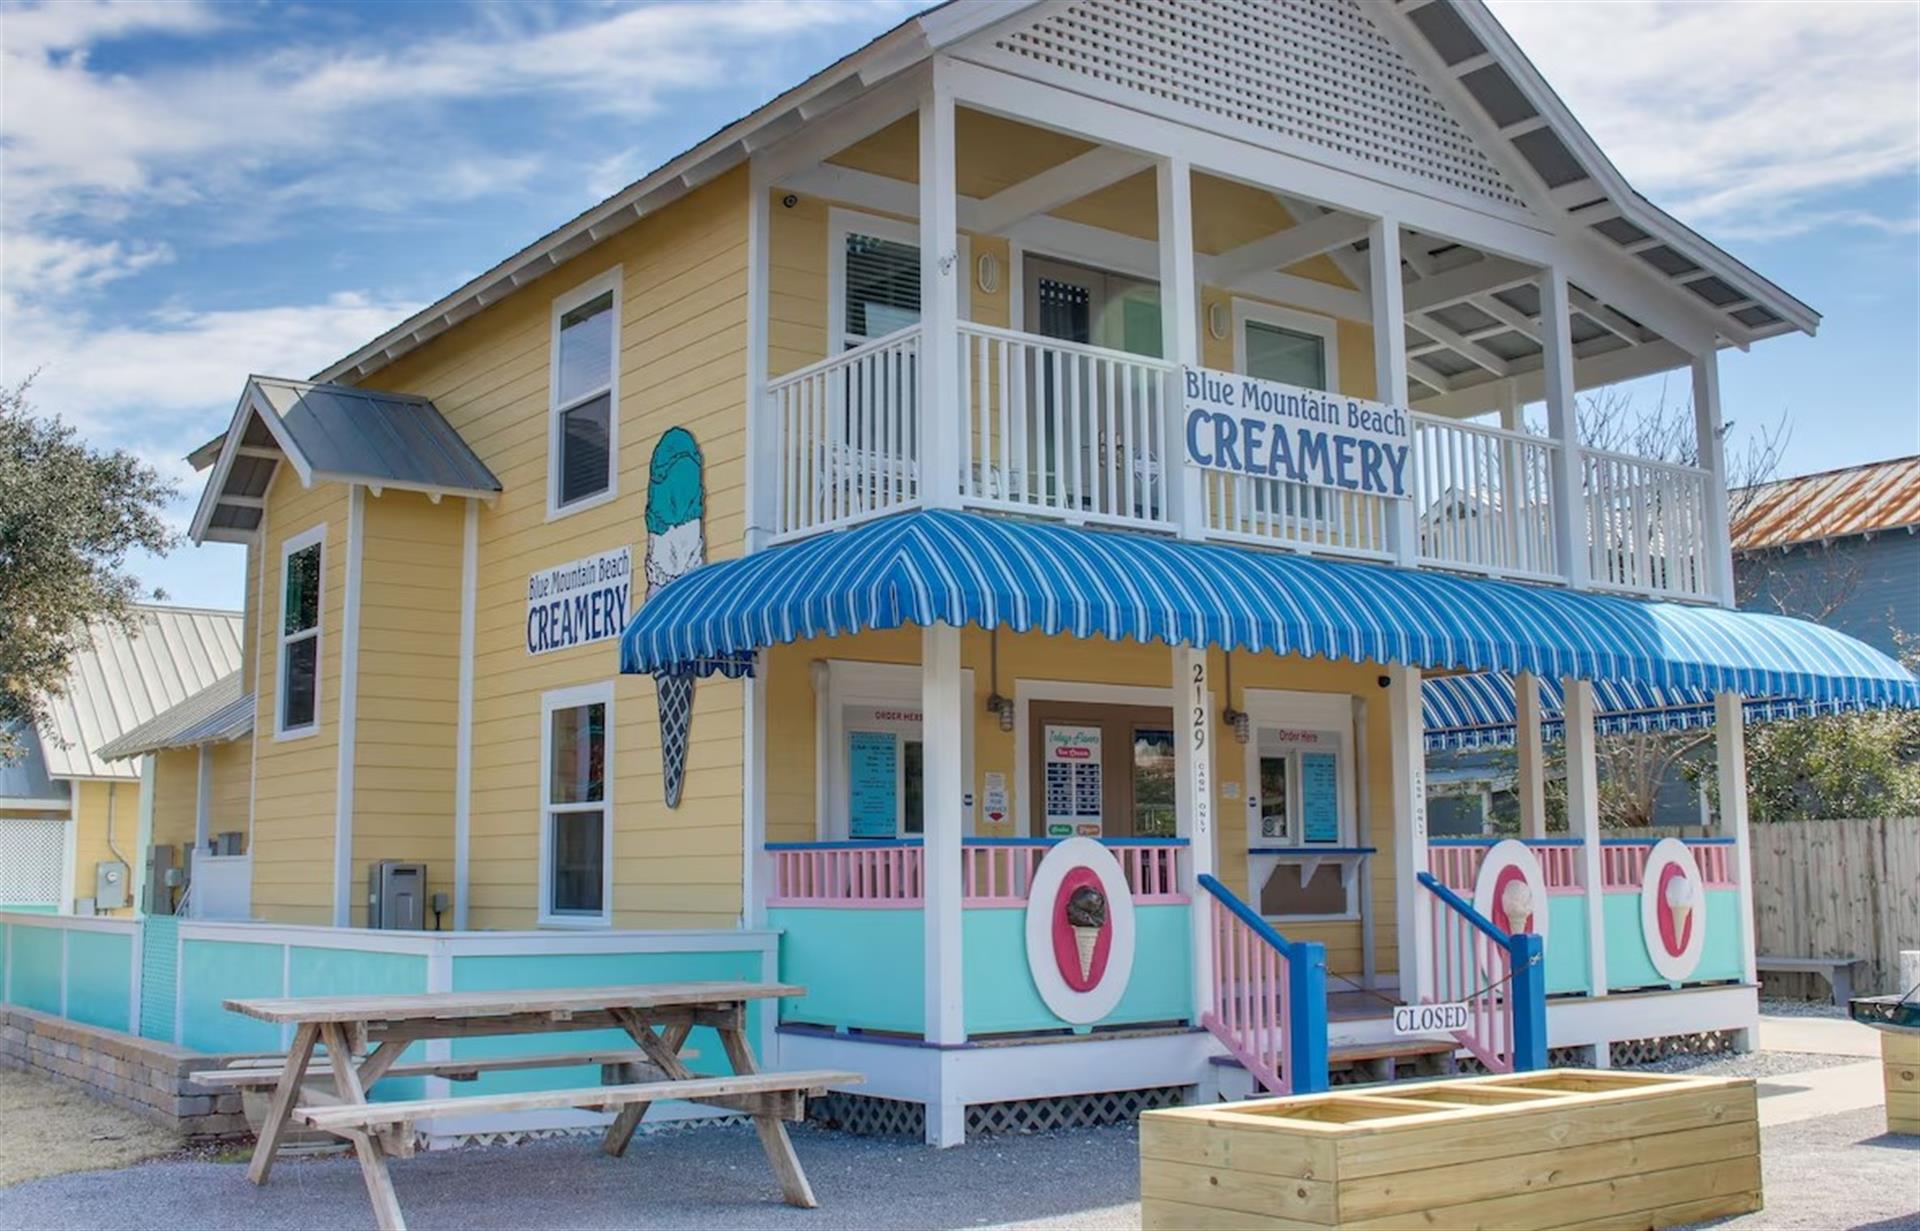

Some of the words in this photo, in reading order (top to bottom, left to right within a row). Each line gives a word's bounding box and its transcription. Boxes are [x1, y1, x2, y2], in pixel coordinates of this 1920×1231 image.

[1186, 370, 1234, 406] Blue
[1242, 381, 1340, 425] Mountain
[1347, 401, 1406, 437] Beach
[1186, 408, 1409, 496] CREAMERY
[529, 575, 549, 600] Blue
[551, 561, 596, 595] Mountain
[599, 549, 629, 582] Beach
[527, 583, 628, 654] CREAMERY
[874, 711, 901, 720] ORDER
[1193, 663, 1204, 751] 2129
[1279, 729, 1299, 741] Order
[1300, 730, 1318, 742] Here
[1198, 763, 1206, 792] CASH
[1198, 803, 1207, 832] ONLY
[1396, 1006, 1467, 1032] CLOSED
